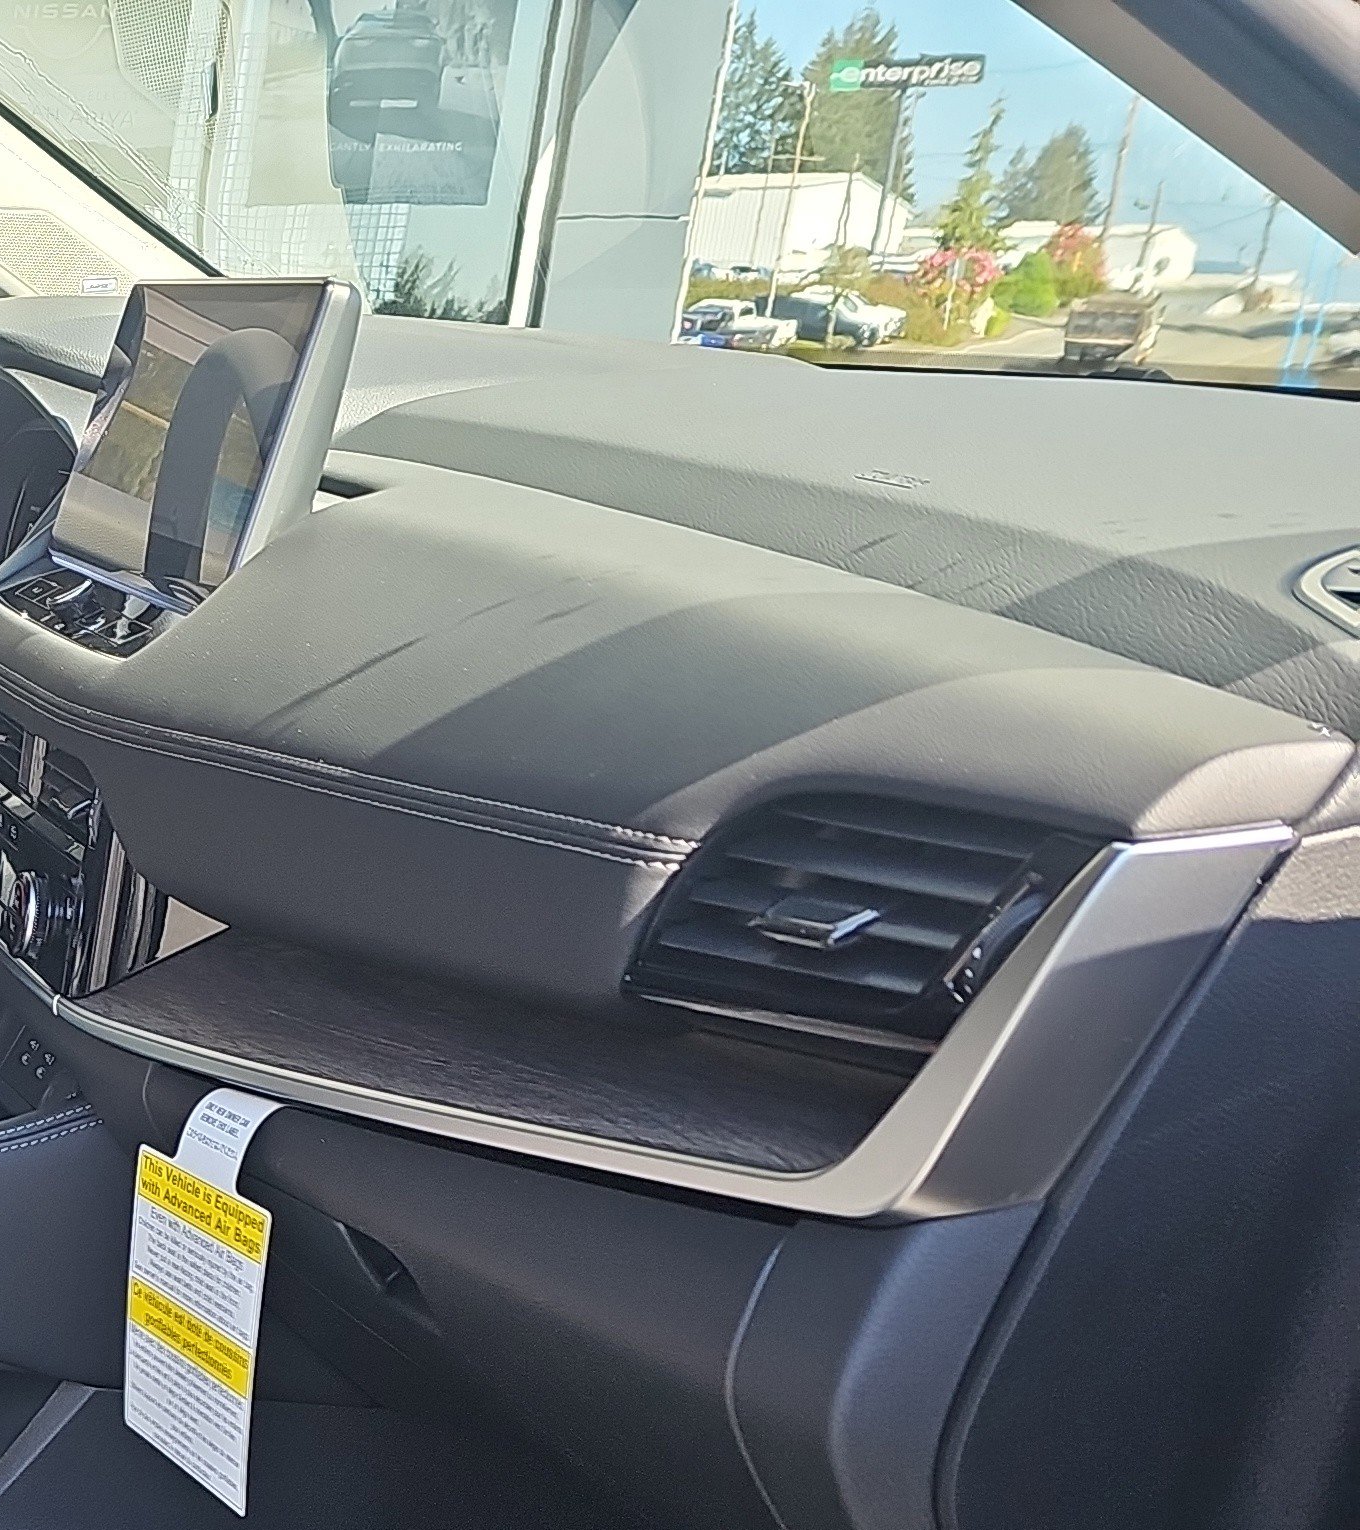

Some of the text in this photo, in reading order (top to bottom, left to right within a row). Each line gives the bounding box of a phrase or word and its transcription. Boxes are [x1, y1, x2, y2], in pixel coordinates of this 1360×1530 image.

[831, 57, 982, 84] enterprise
[379, 141, 463, 153] EXHILARATING
[141, 1177, 261, 1255] with Advanced Air Bags
[142, 1154, 265, 1234] This Vehicle is Equipped
